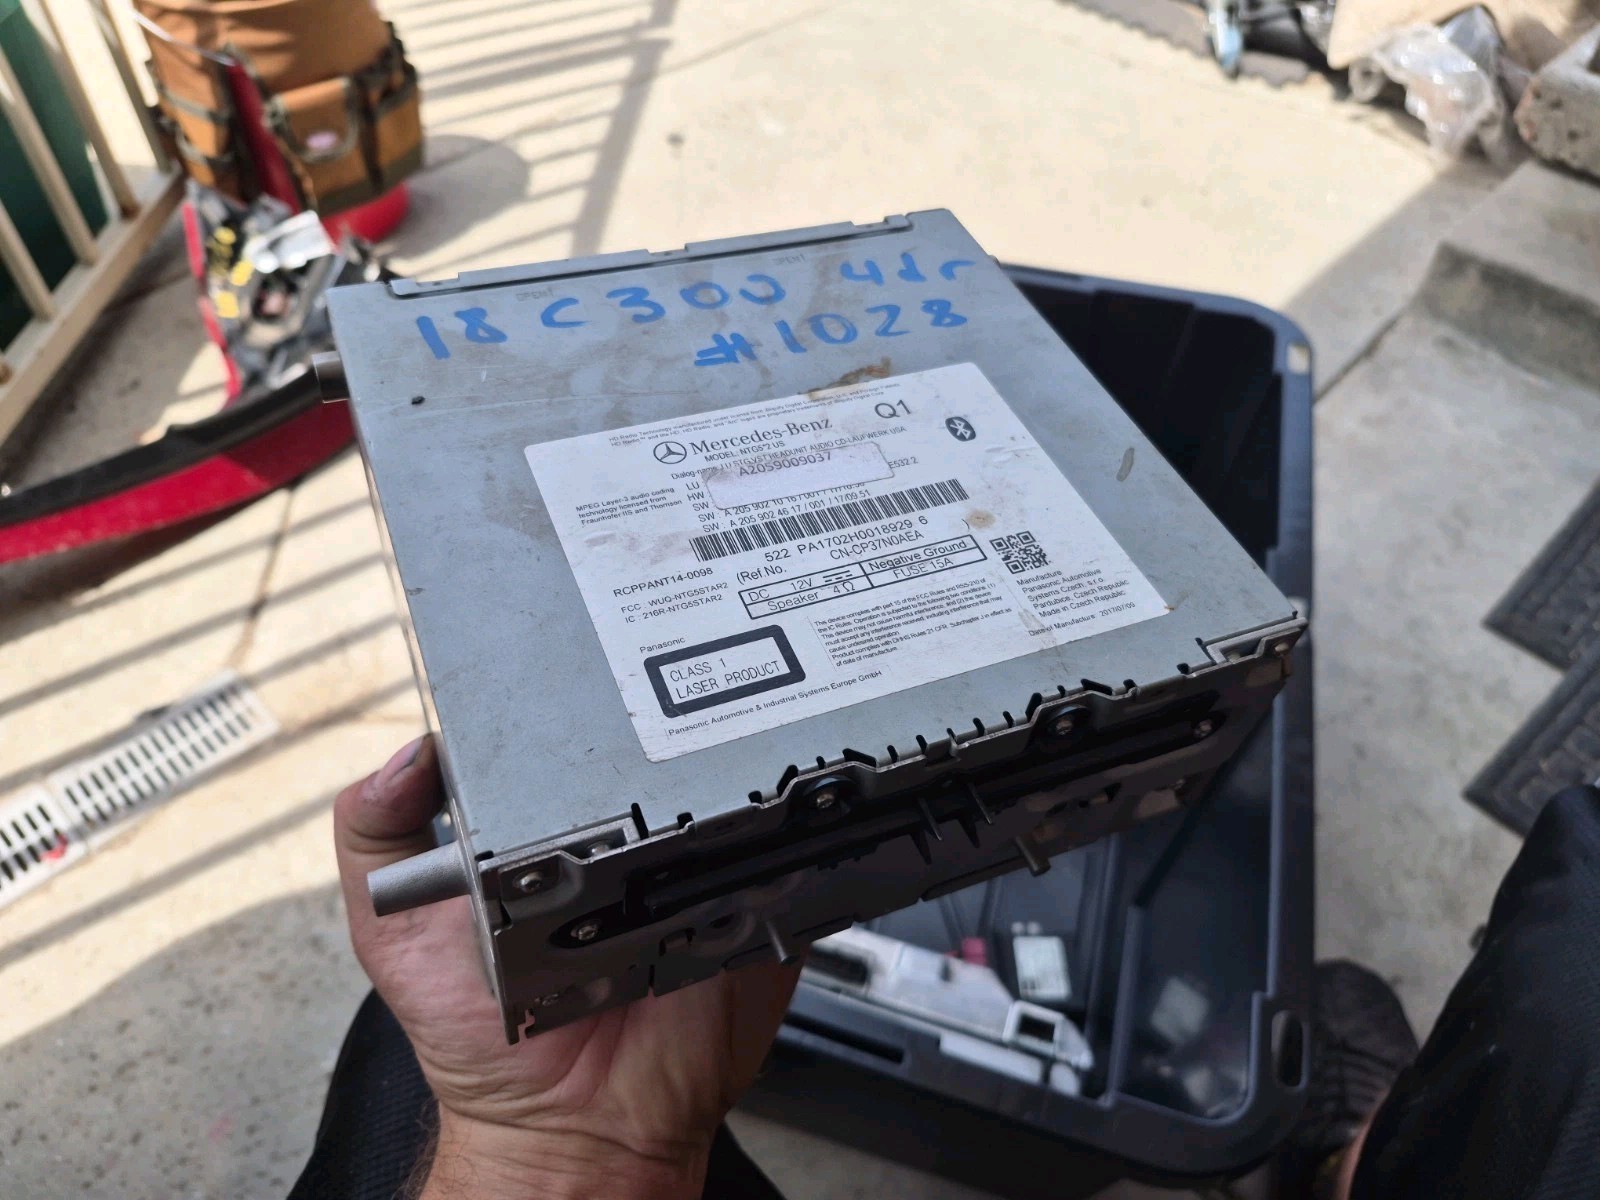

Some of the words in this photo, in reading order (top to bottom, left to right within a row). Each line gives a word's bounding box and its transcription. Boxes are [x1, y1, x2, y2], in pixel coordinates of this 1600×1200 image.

[416, 307, 508, 359] 18
[694, 299, 968, 367] #1028
[875, 400, 911, 419] Q1
[690, 420, 832, 454] Mercedes-Benz
[810, 441, 834, 451] AUDIO
[740, 450, 831, 476] A2059009037
[686, 482, 700, 491] LU
[687, 492, 704, 501] HW
[579, 507, 617, 518] technology
[581, 514, 621, 525] Fraunhofer
[650, 500, 682, 510] Thomson
[693, 502, 709, 512] SW
[698, 512, 715, 522] SW
[703, 523, 719, 533] SW
[738, 515, 756, 526] 205
[758, 511, 775, 520] 902
[809, 500, 825, 509] 001
[765, 549, 791, 562] 522
[798, 520, 912, 554] PA1702H0018929
[918, 516, 928, 525] 6
[869, 554, 924, 573] Negative
[924, 540, 967, 557] Ground
[893, 563, 928, 579] FUSE
[930, 558, 954, 569] 15A
[614, 568, 713, 597] RCPPANT14-0098
[748, 589, 770, 602] DC
[791, 578, 812, 590] 12V
[1022, 580, 1061, 593] Panasonic
[1062, 569, 1101, 583] Automotive
[1074, 589, 1098, 599] Czech
[1097, 580, 1129, 591] Republic
[768, 592, 820, 613] Speaker
[1028, 590, 1060, 602] Systems
[1070, 599, 1094, 610] Czech
[1094, 591, 1126, 602] Republic
[621, 604, 642, 613] FCC
[640, 638, 685, 653] Panasonic
[832, 650, 855, 660] Product
[670, 662, 712, 682] CLASS
[676, 678, 718, 699] LASER
[725, 661, 780, 684] PRODUCT
[669, 721, 709, 736] Panasonic
[712, 708, 754, 724] Automotive
[764, 695, 797, 708] Industrial
[798, 686, 830, 698] Systems
[830, 679, 857, 690] Europe
[858, 671, 882, 682] GmbH
